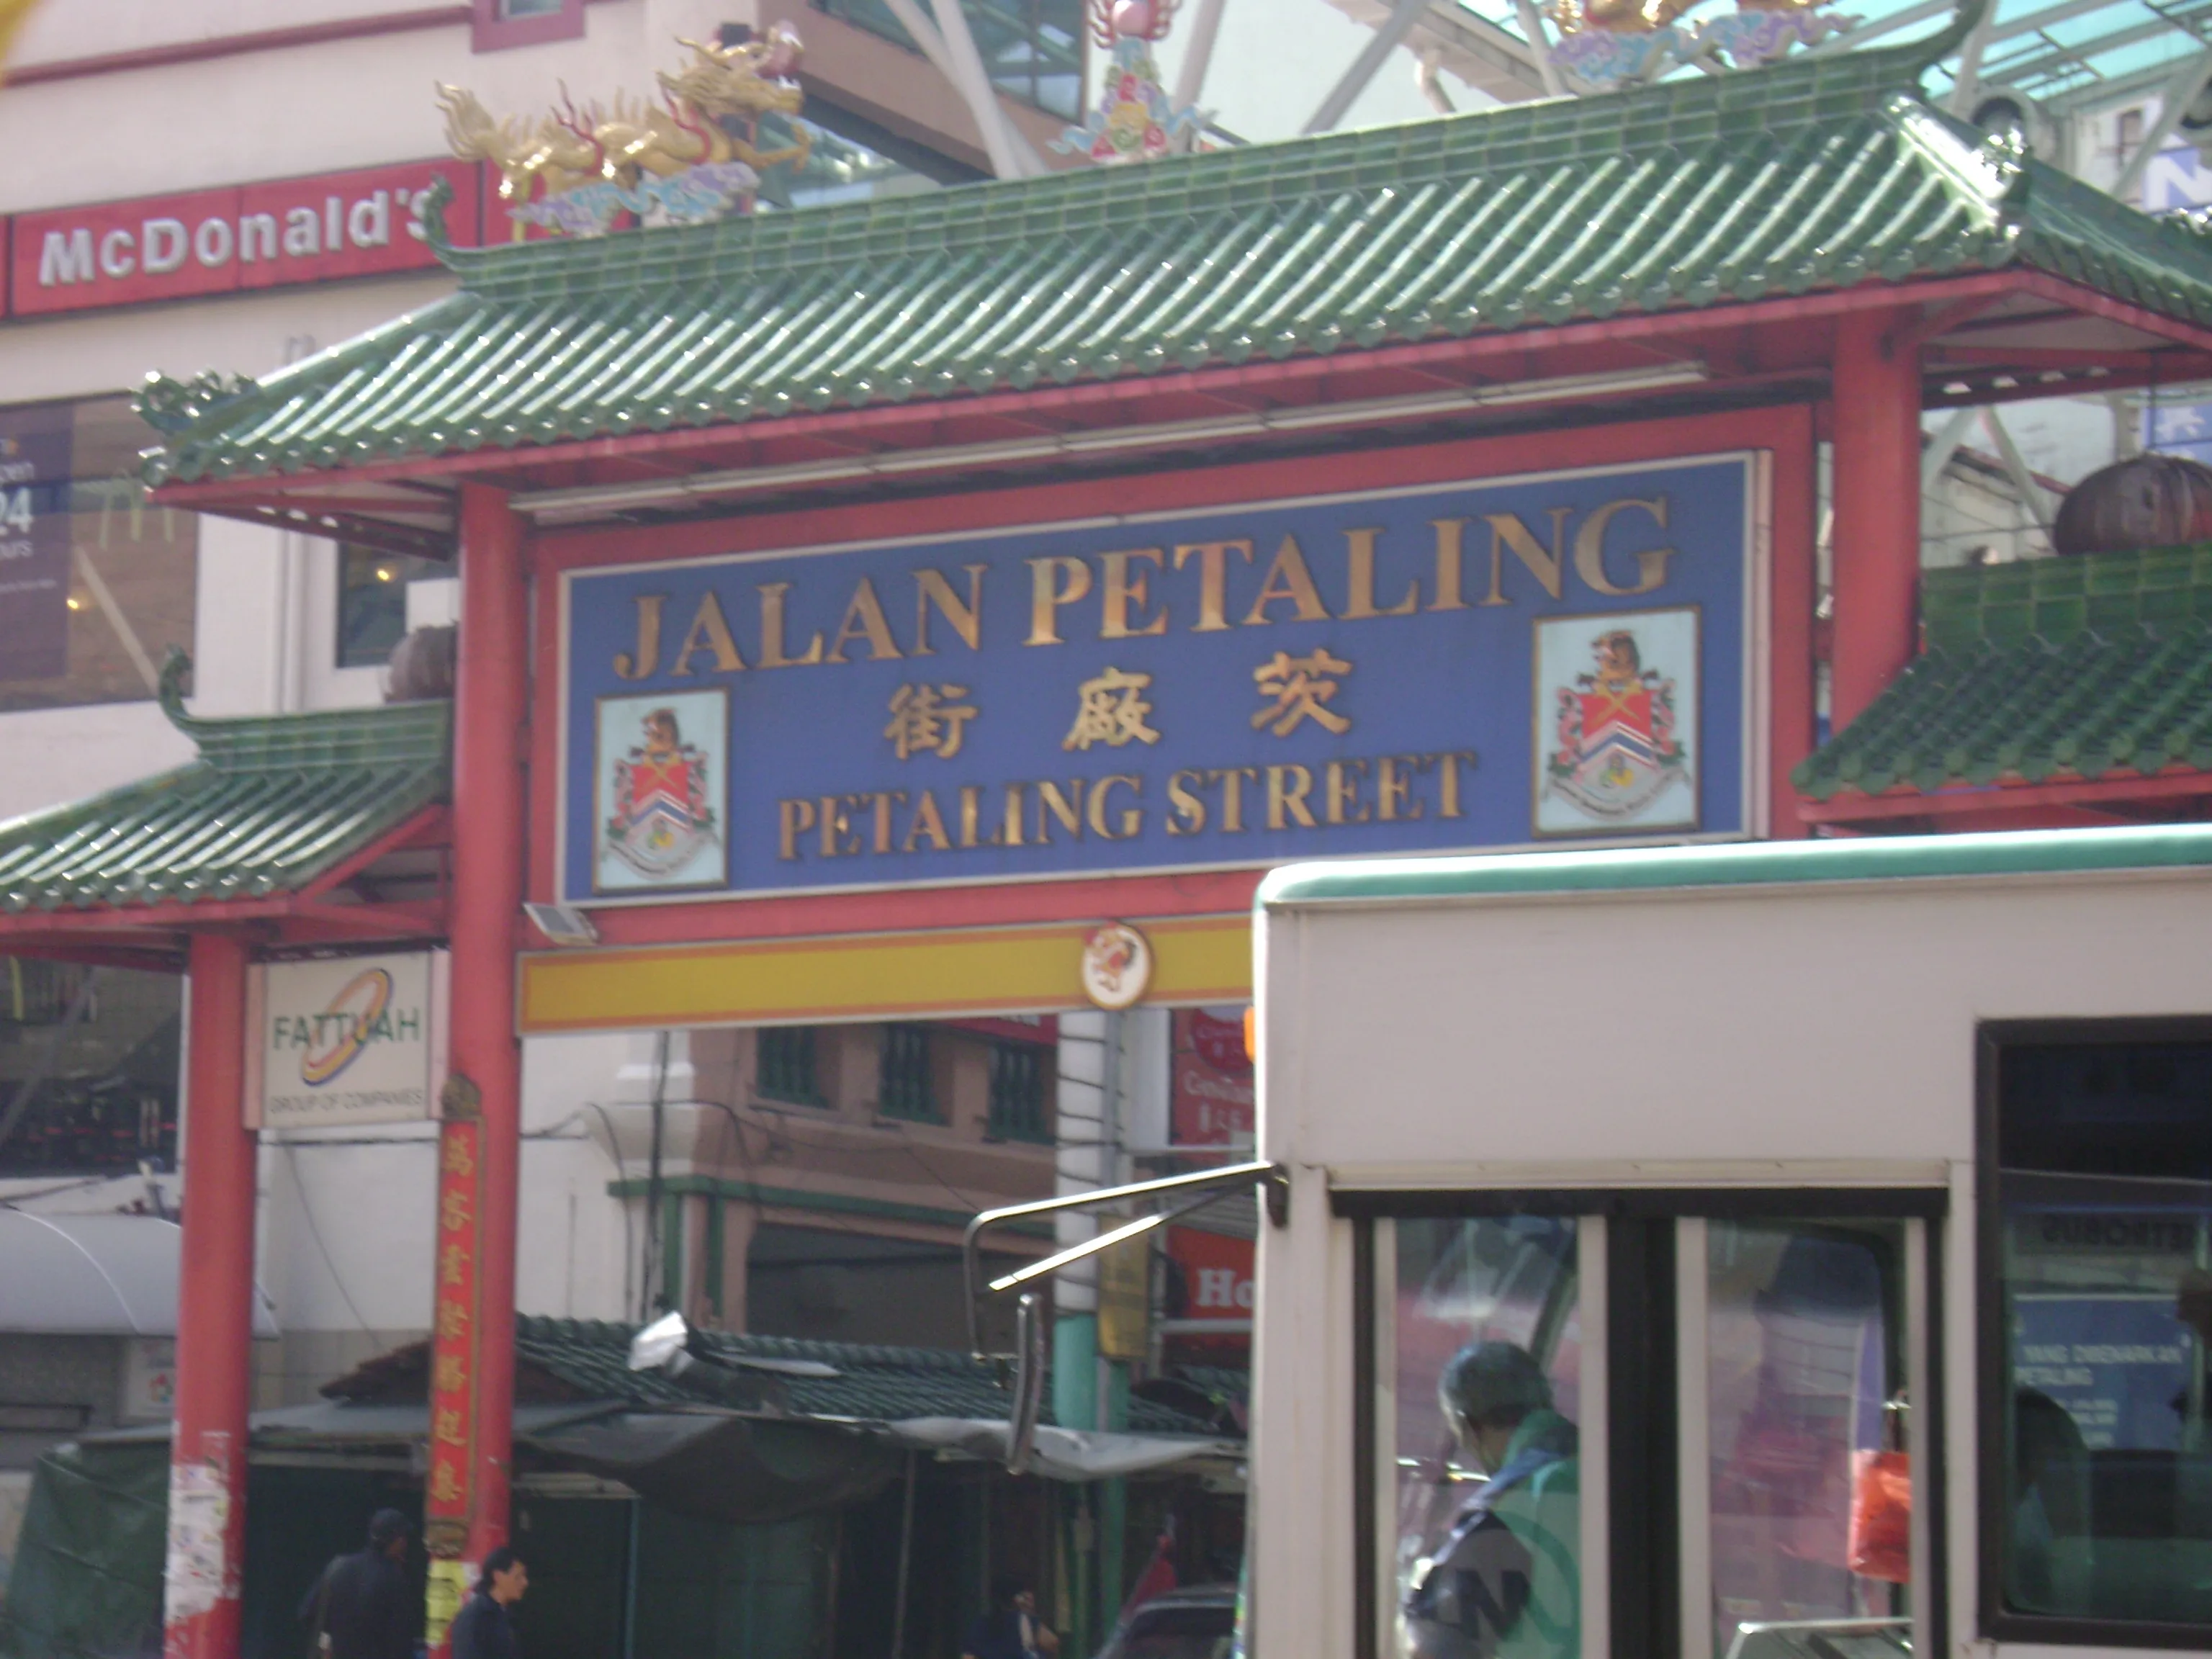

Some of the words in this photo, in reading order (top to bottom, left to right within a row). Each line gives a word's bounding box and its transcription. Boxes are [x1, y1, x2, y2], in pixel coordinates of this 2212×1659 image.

[38, 189, 434, 287] McDonald's
[613, 563, 987, 680] JALAN
[1022, 497, 1676, 647] PETALING
[778, 775, 1146, 860] PETALING
[1165, 750, 1476, 836] STREET
